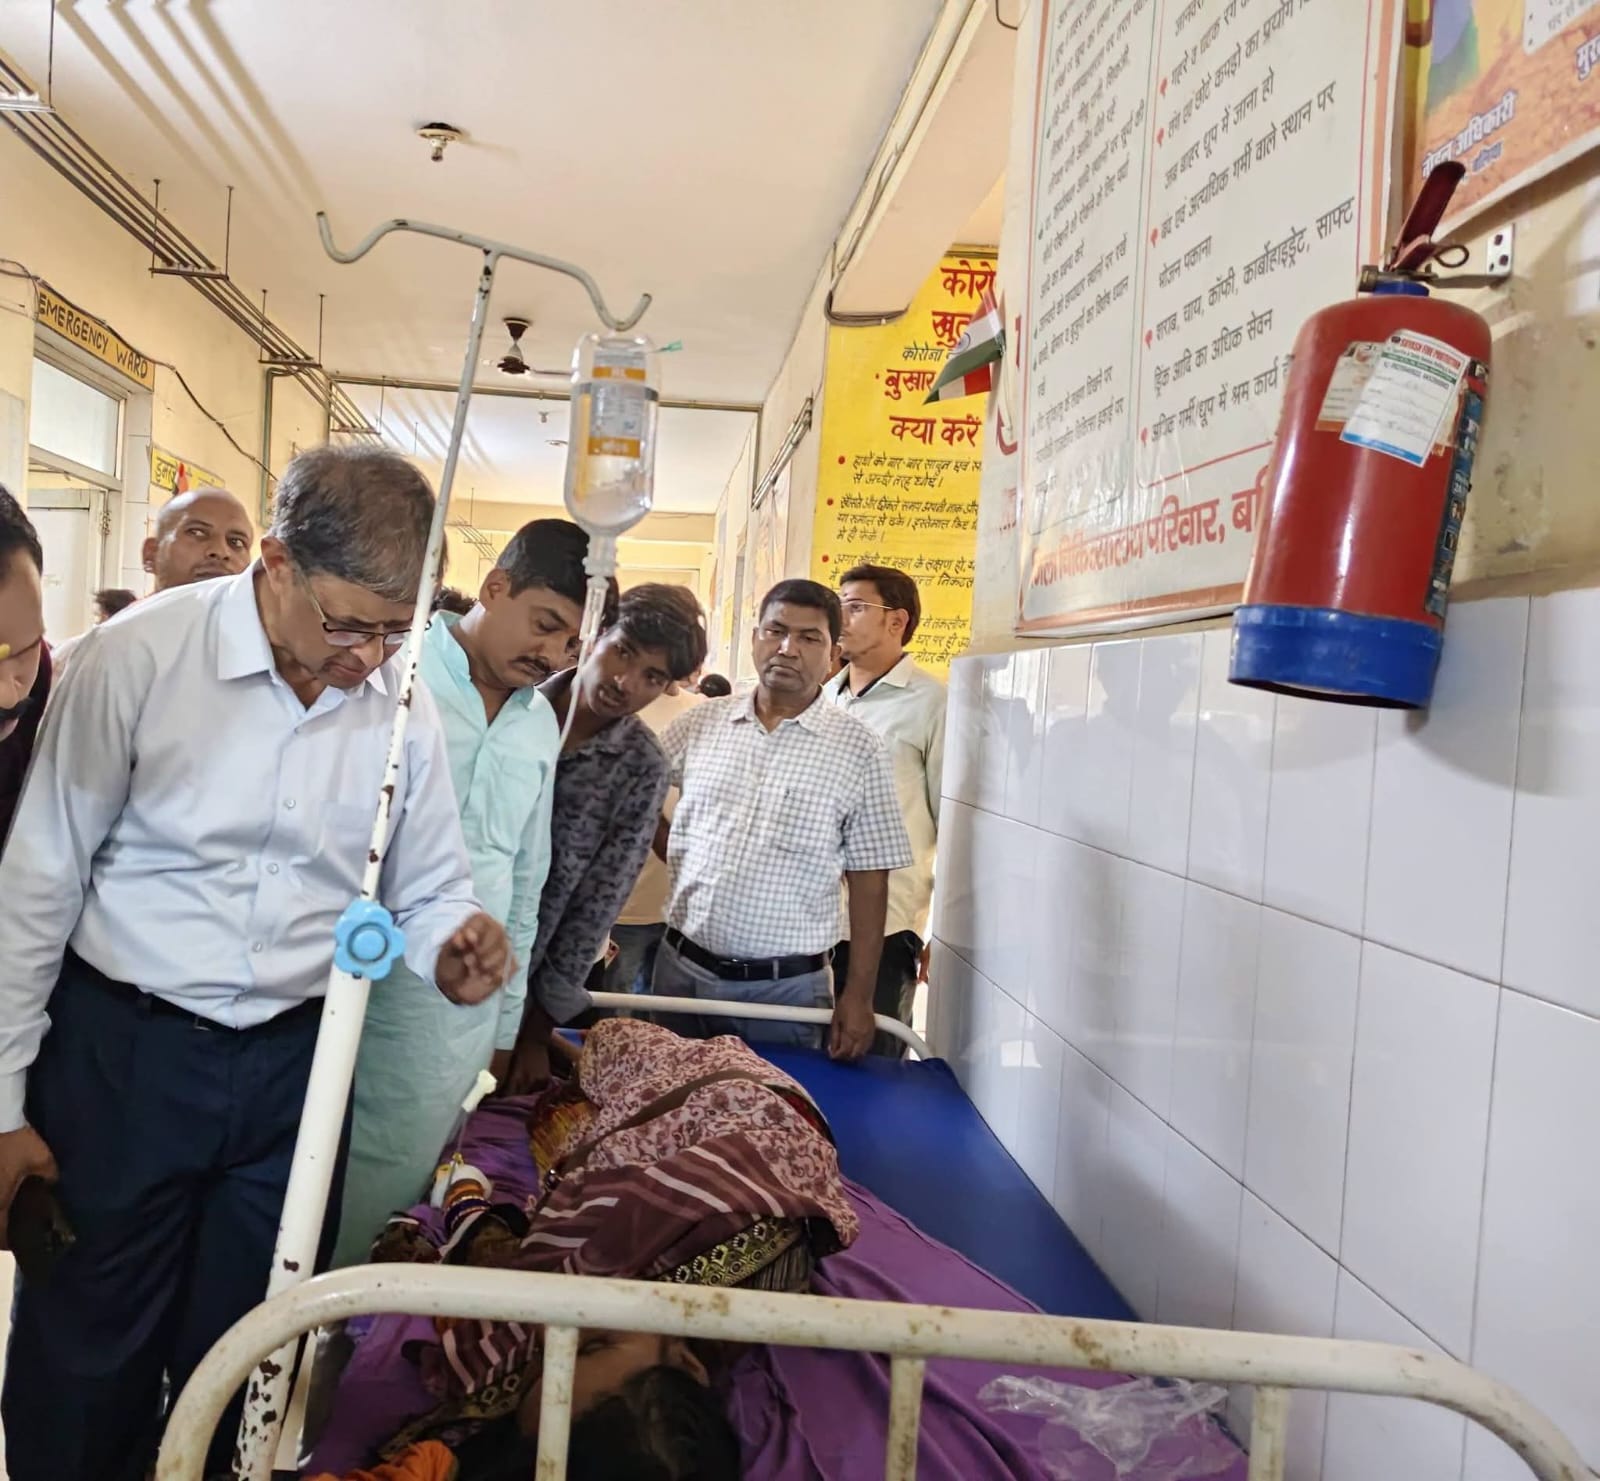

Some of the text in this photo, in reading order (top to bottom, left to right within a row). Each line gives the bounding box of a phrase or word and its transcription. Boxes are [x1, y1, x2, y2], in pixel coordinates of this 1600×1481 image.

[1245, 29, 1260, 58] का
[1203, 122, 1219, 159] धूप
[1222, 103, 1232, 134] में
[1233, 86, 1259, 126] जाना
[1262, 65, 1275, 102] हो
[1189, 167, 1230, 217] अत्यधिक
[1232, 138, 1254, 179] गर्मी
[1256, 120, 1278, 161] वाले
[1281, 99, 1313, 142] स्थान
[1317, 80, 1337, 112] पर
[1315, 195, 1356, 241] साफ्ट
[1158, 235, 1213, 290] भोजन पकाना
[38, 291, 149, 380] EMERGENCY WARD
[902, 340, 945, 363] कोरोना
[1172, 347, 1193, 382] आदि
[1195, 344, 1209, 369] का
[1211, 325, 1244, 361] अधिक
[1246, 307, 1274, 342] सेवन
[885, 368, 937, 401] बुखार
[1218, 381, 1229, 412] में
[1231, 379, 1251, 406] श्रम
[1253, 355, 1280, 397] कार्य
[889, 413, 983, 448] क्या करें
[853, 468, 864, 485] से
[893, 474, 914, 492] तरह
[877, 512, 888, 527] से
[1145, 494, 1227, 555] परिवार,
[914, 553, 925, 569] के
[925, 558, 953, 573] लक्षण
